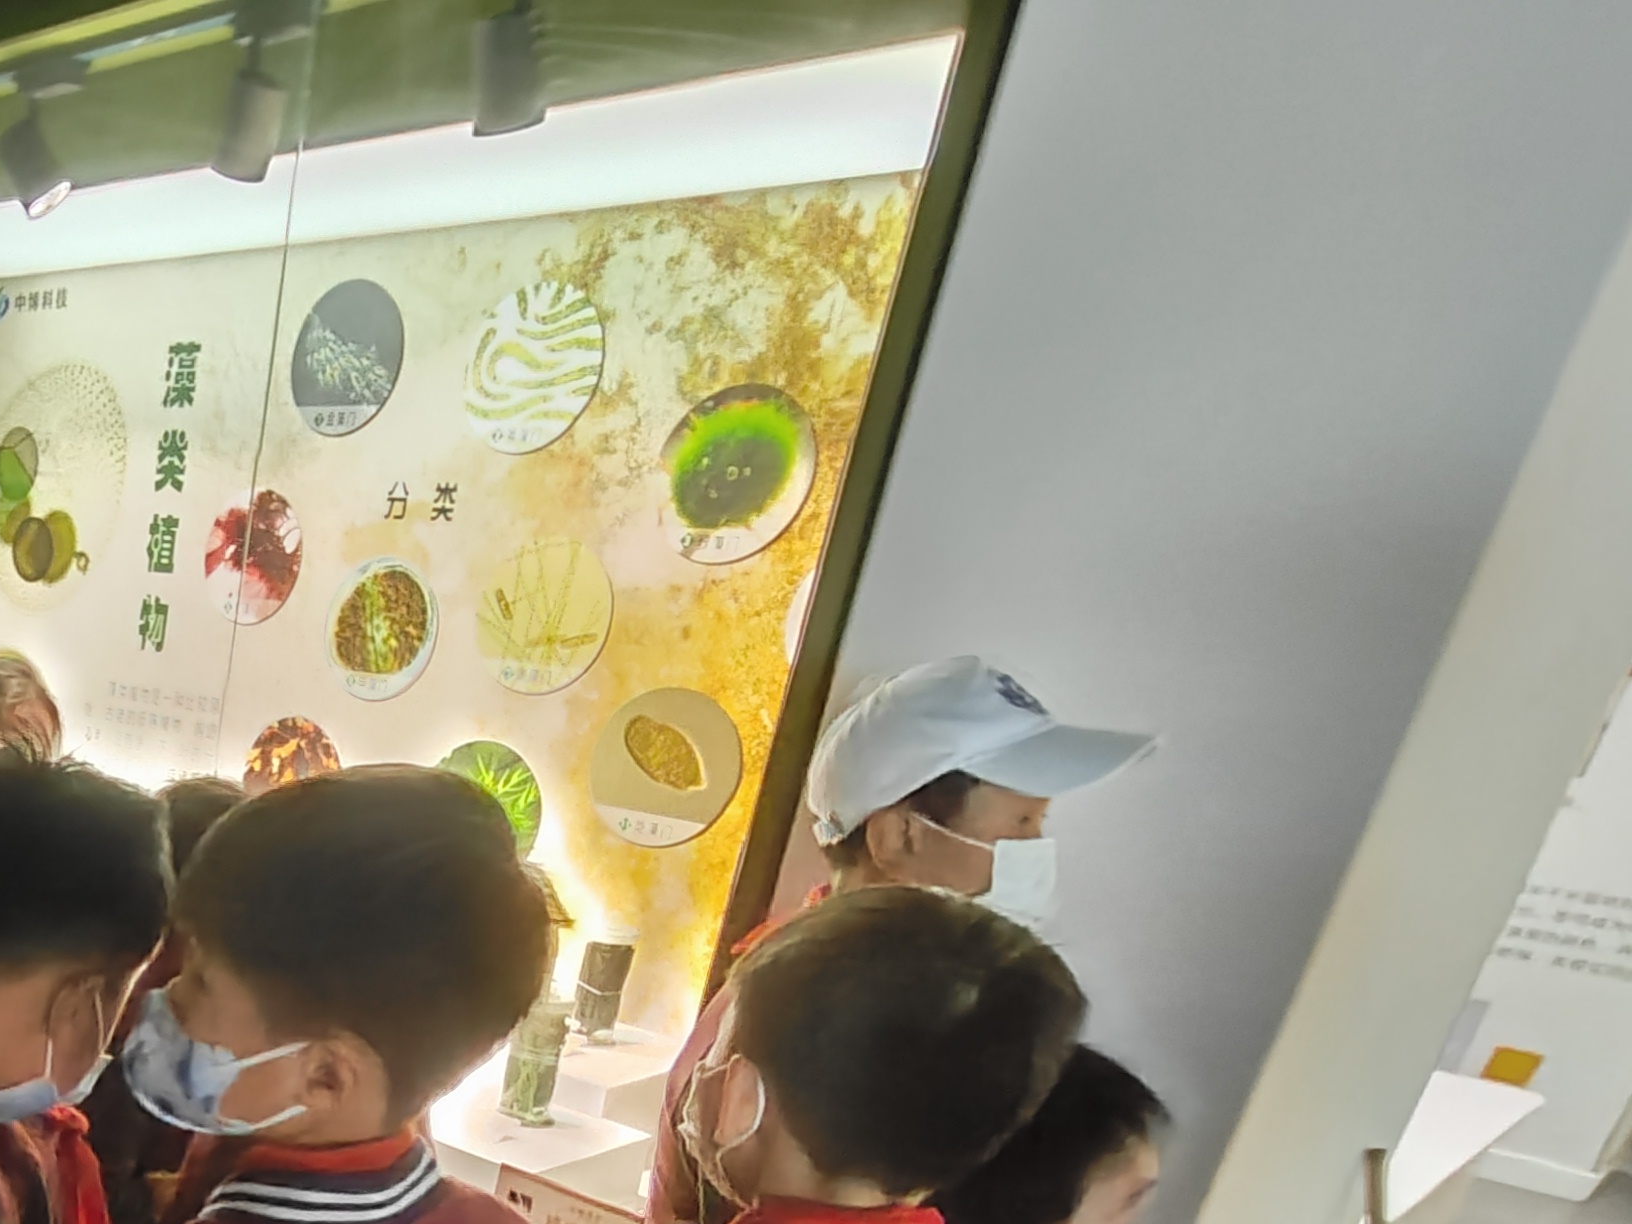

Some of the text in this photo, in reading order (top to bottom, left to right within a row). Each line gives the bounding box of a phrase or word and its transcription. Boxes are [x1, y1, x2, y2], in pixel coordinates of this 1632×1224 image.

[137, 341, 202, 653] 藻类植物
[384, 481, 458, 521] 分类
